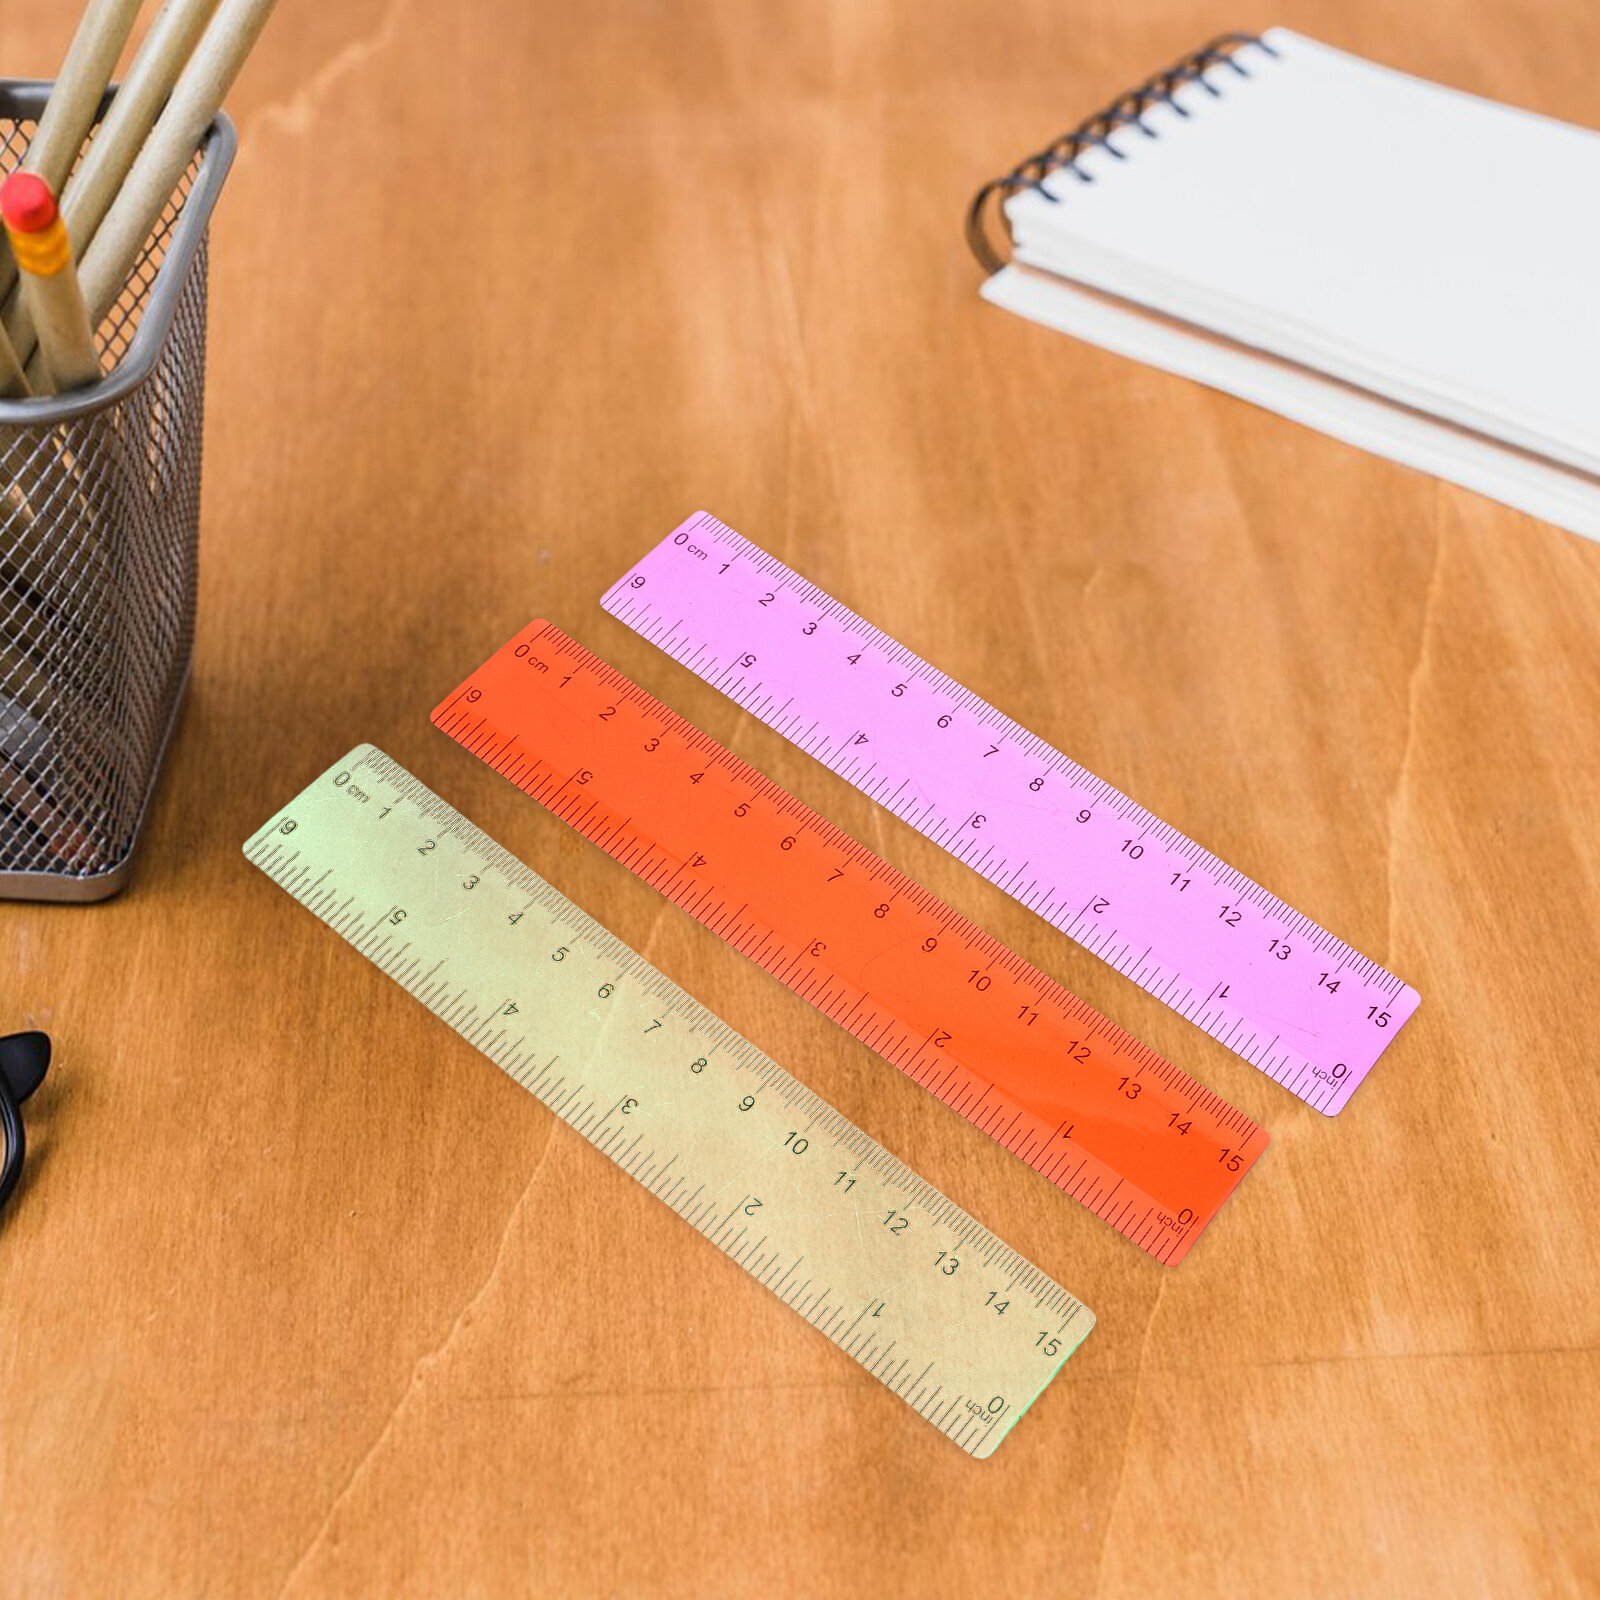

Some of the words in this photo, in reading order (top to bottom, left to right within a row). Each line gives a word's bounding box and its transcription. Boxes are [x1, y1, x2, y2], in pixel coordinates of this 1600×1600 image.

[739, 654, 757, 669] 5
[853, 732, 869, 746] 4
[575, 770, 593, 786] 5
[673, 532, 690, 546] 0
[686, 544, 708, 561] cm
[718, 563, 731, 575] 1
[758, 592, 776, 608] 2
[802, 621, 818, 636] 3
[846, 653, 862, 666] 4
[891, 683, 908, 698] 5
[936, 714, 953, 729] 6
[983, 744, 1000, 758] 7
[1028, 777, 1045, 792] 8
[1075, 809, 1092, 824] 9
[1121, 839, 1144, 860] 10
[1170, 872, 1192, 892] 11
[1218, 905, 1243, 928] 12
[1268, 939, 1292, 961] 13
[1317, 972, 1341, 995] 14
[1367, 1006, 1392, 1028] 15
[971, 814, 987, 829] 3
[691, 854, 707, 868] 4
[514, 644, 531, 658] 0
[527, 656, 549, 674] cm
[559, 676, 573, 689] 1
[598, 705, 617, 722] 2
[643, 737, 662, 753] 3
[689, 772, 705, 785] 4
[733, 802, 752, 818] 5
[780, 835, 797, 851] 6
[826, 868, 845, 882] 7
[873, 903, 890, 919] 8
[921, 937, 938, 953] 9
[967, 970, 992, 992] 10
[1017, 1005, 1040, 1026] 11
[1066, 1040, 1092, 1065] 12
[1117, 1076, 1142, 1100] 13
[1168, 1112, 1193, 1136] 14
[1218, 1148, 1245, 1172] 15
[1092, 897, 1111, 914] 2
[388, 908, 407, 927] 5
[810, 941, 827, 958] 3
[1218, 985, 1231, 999] 1
[502, 1002, 520, 1016] 4
[934, 1031, 953, 1048] 2
[333, 771, 352, 788] 0
[346, 784, 371, 804] cm
[378, 806, 393, 820] 1
[416, 838, 438, 857] 2
[462, 873, 481, 891] 3
[507, 911, 524, 926] 4
[551, 945, 570, 962] 5
[597, 982, 616, 999] 6
[643, 1018, 663, 1034] 7
[690, 1056, 708, 1075] 8
[738, 1095, 756, 1112] 9
[783, 1131, 809, 1155] 10
[834, 1170, 857, 1194] 11
[883, 1209, 910, 1237] 12
[934, 1251, 960, 1276] 13
[984, 1291, 1012, 1316] 14
[1035, 1331, 1063, 1357] 15
[1331, 1063, 1347, 1079] 0
[1311, 1065, 1339, 1091] inch
[621, 1098, 639, 1115] 3
[1062, 1124, 1075, 1139] 1
[744, 1197, 764, 1216] 2
[1156, 1210, 1185, 1239] inch
[1177, 1208, 1194, 1225] 0
[870, 1302, 886, 1318] 1
[965, 1398, 994, 1428] inch
[987, 1395, 1005, 1415] 0
